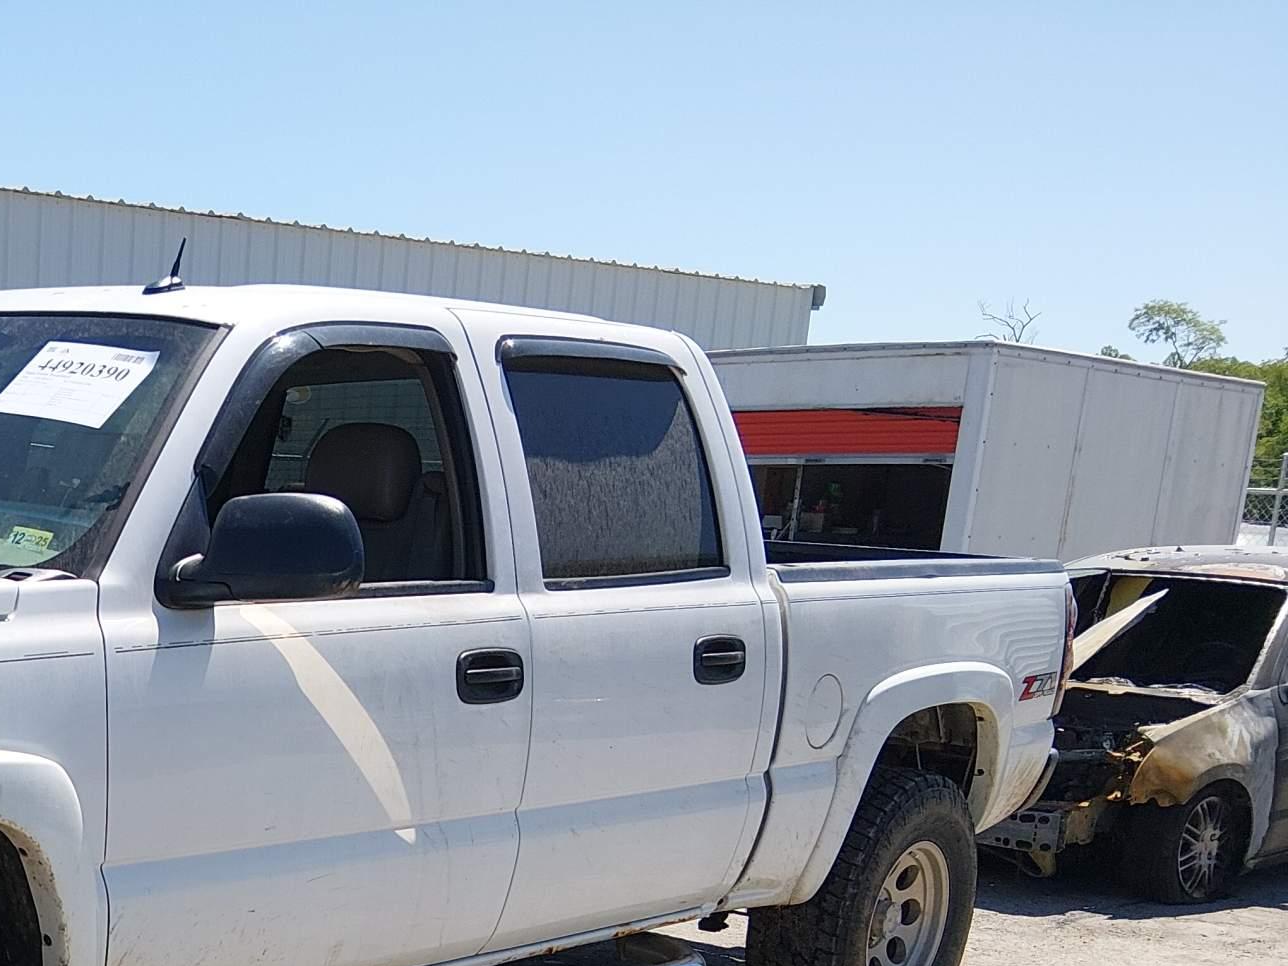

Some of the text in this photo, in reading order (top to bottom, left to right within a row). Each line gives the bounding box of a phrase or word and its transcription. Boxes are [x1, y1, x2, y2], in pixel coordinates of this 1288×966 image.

[38, 357, 131, 383] 44920390
[11, 531, 26, 545] 12
[1018, 671, 1058, 702] Z71
